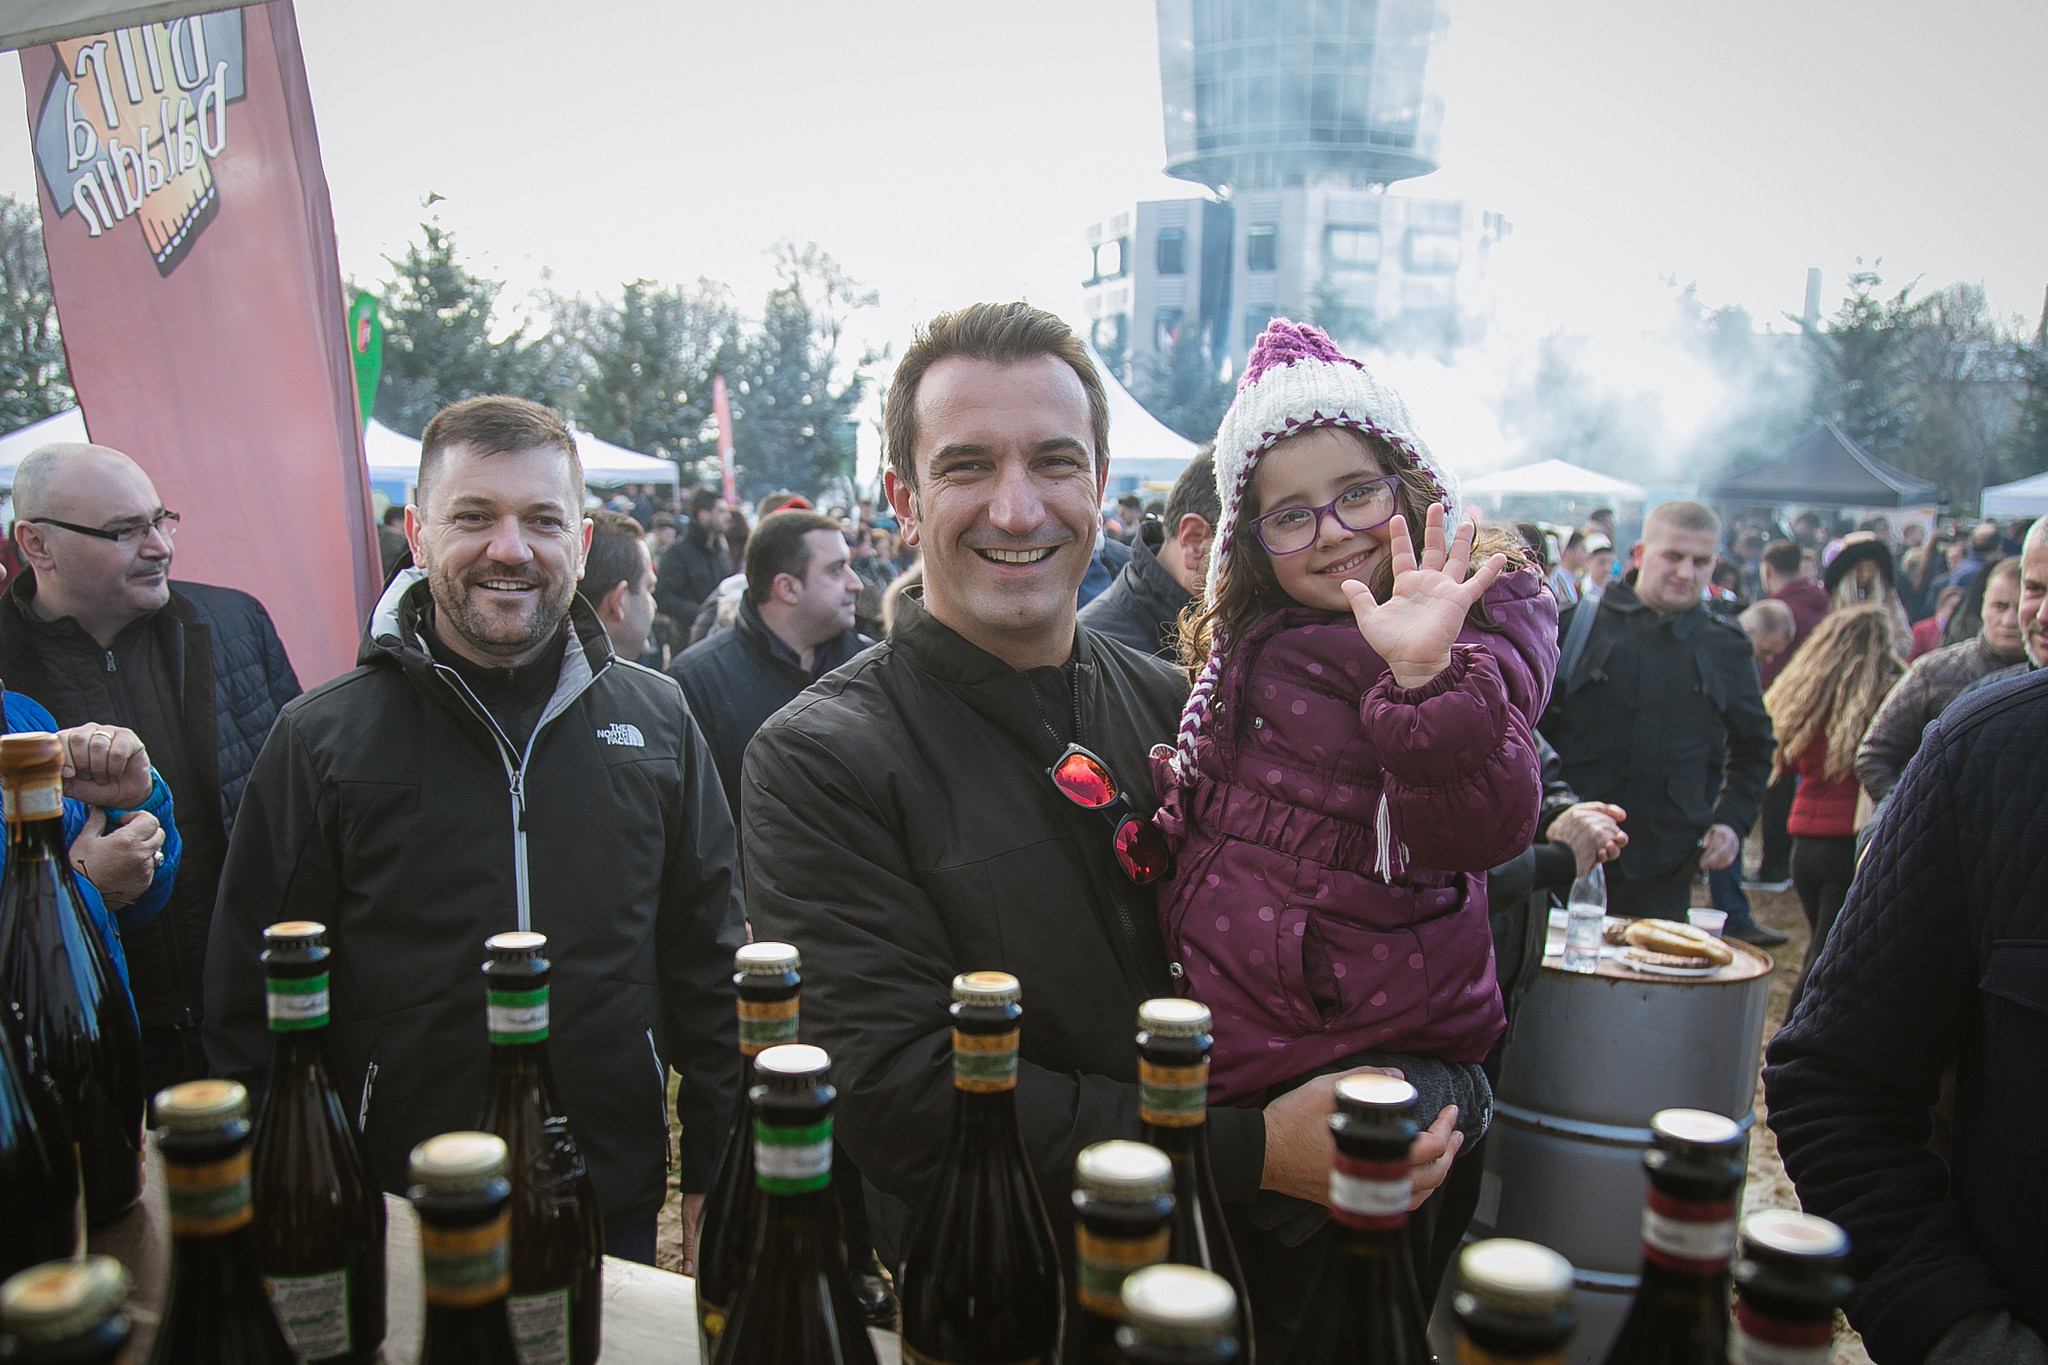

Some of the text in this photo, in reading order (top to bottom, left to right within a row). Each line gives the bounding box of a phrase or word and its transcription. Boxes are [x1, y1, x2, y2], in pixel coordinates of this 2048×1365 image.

[609, 723, 628, 732] THE
[596, 729, 629, 739] NORTH
[607, 737, 631, 746] FACE
